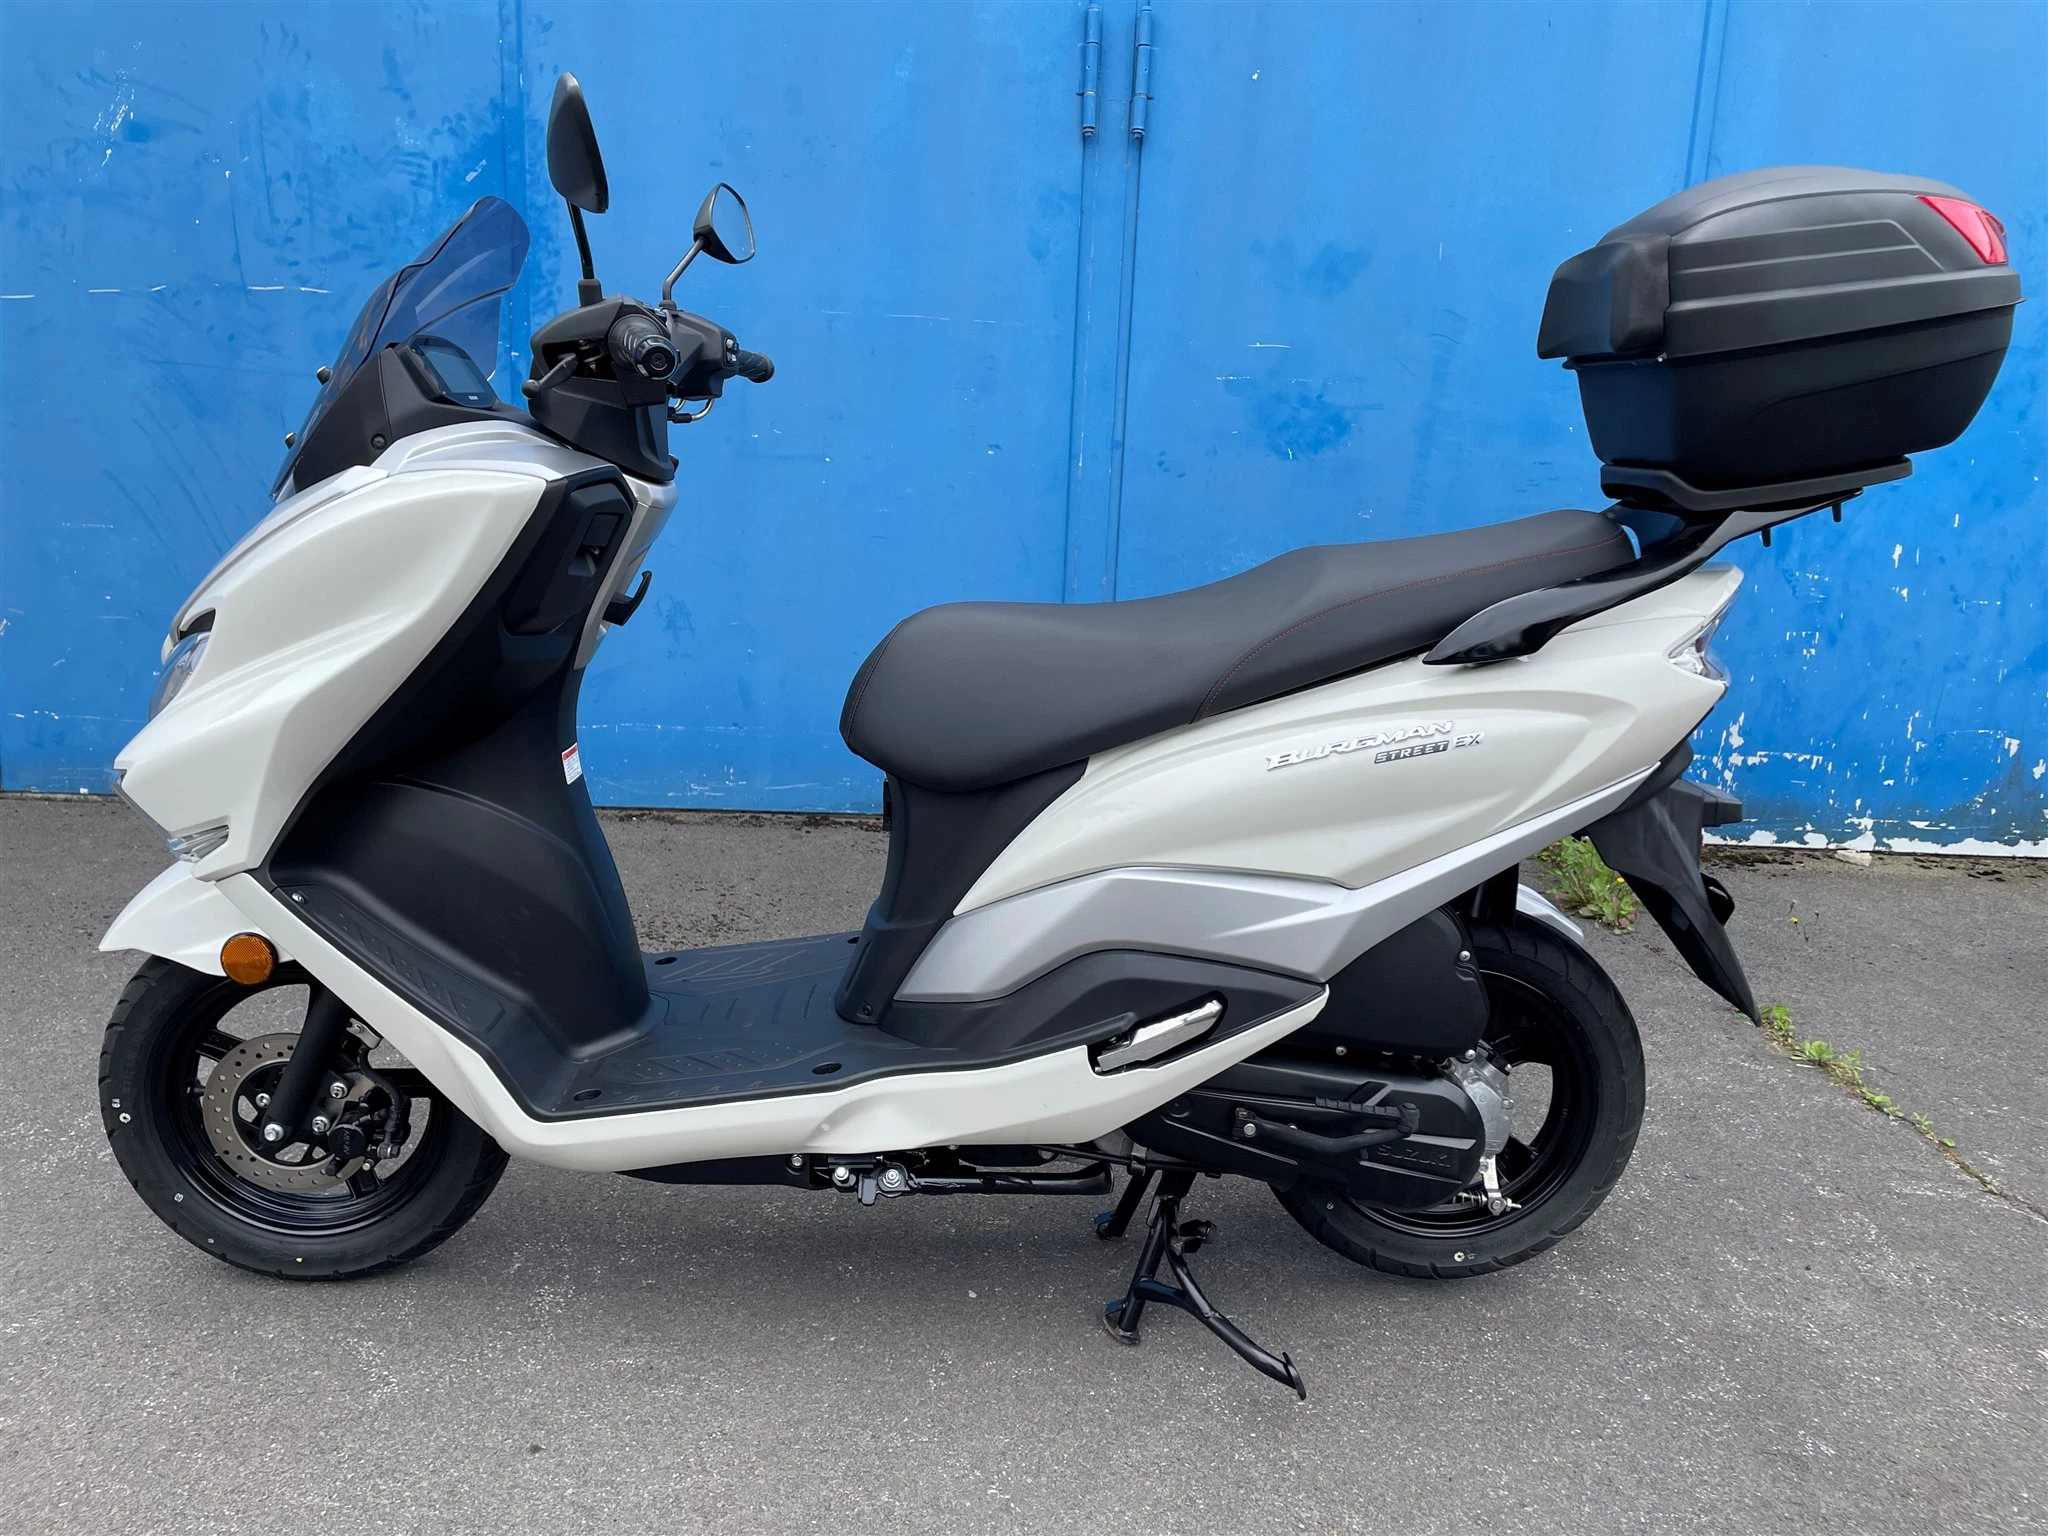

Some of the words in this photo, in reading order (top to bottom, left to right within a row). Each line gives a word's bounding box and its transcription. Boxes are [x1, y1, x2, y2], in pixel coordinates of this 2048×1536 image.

[1266, 720, 1454, 771] BURGMAN
[1374, 740, 1449, 764] STREET
[1454, 731, 1485, 749] EX
[1375, 1142, 1452, 1168] SUZUKI
